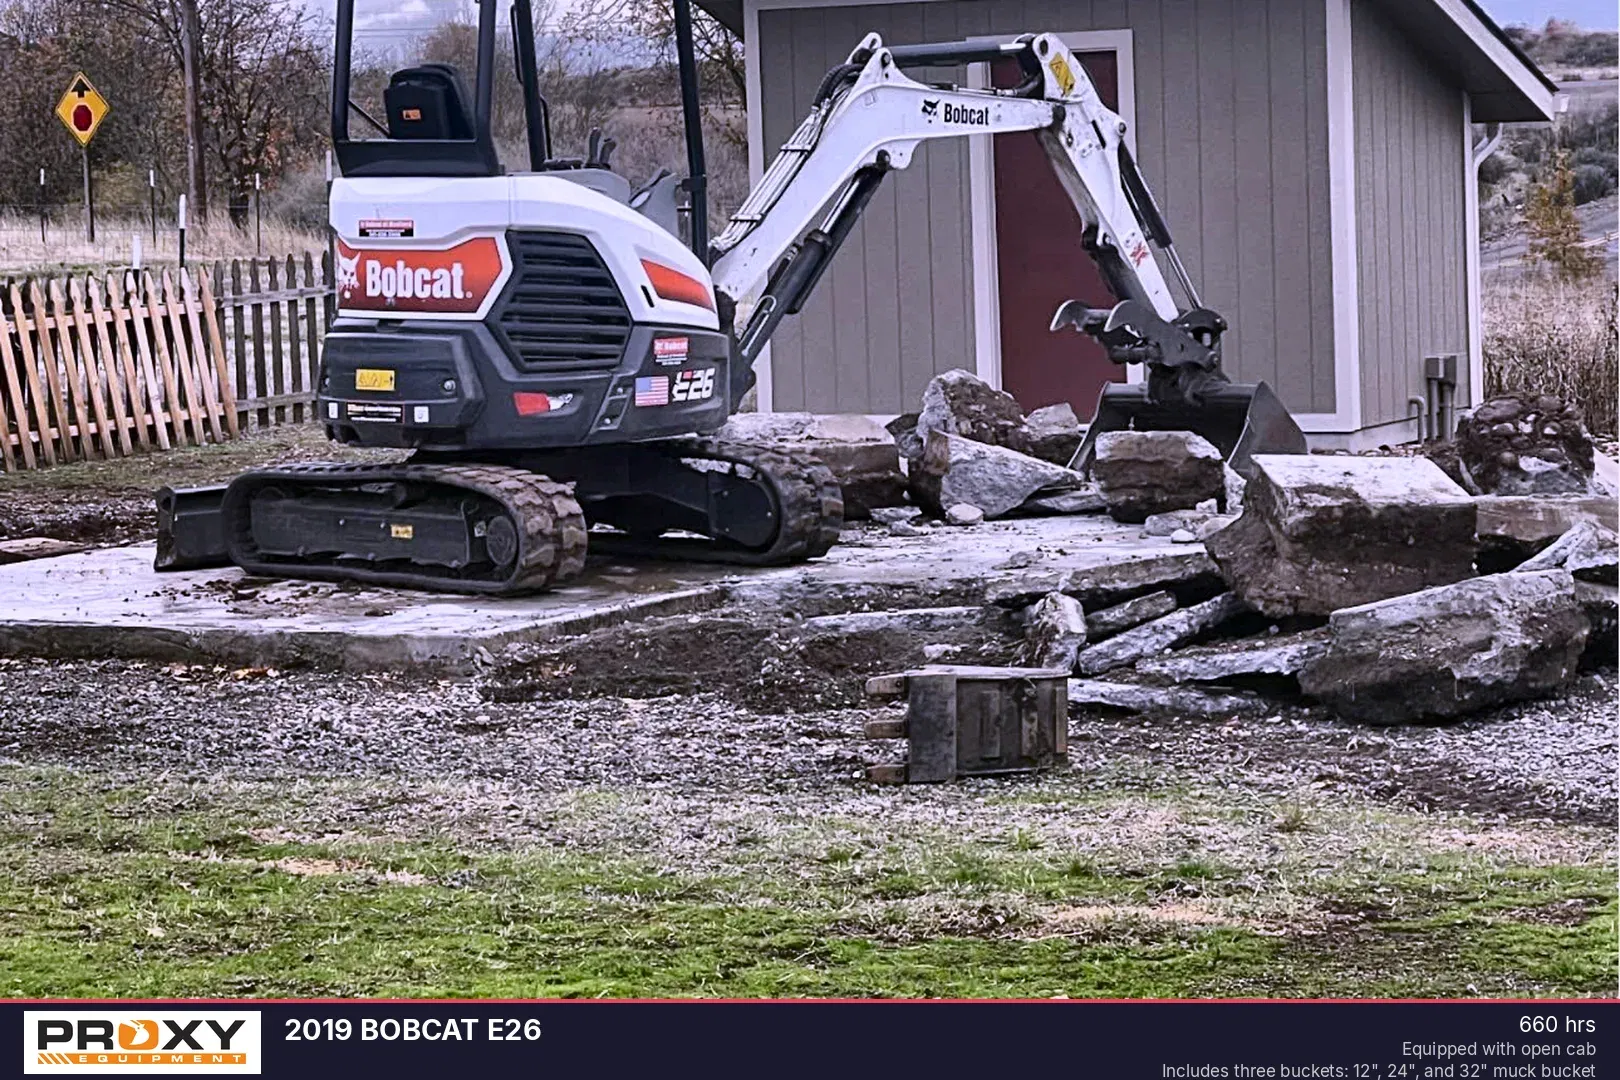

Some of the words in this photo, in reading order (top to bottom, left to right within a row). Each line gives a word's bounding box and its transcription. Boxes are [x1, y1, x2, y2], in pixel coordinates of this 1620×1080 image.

[944, 103, 989, 126] Bobcat
[366, 260, 464, 299] Bobcat
[672, 368, 715, 401] E26
